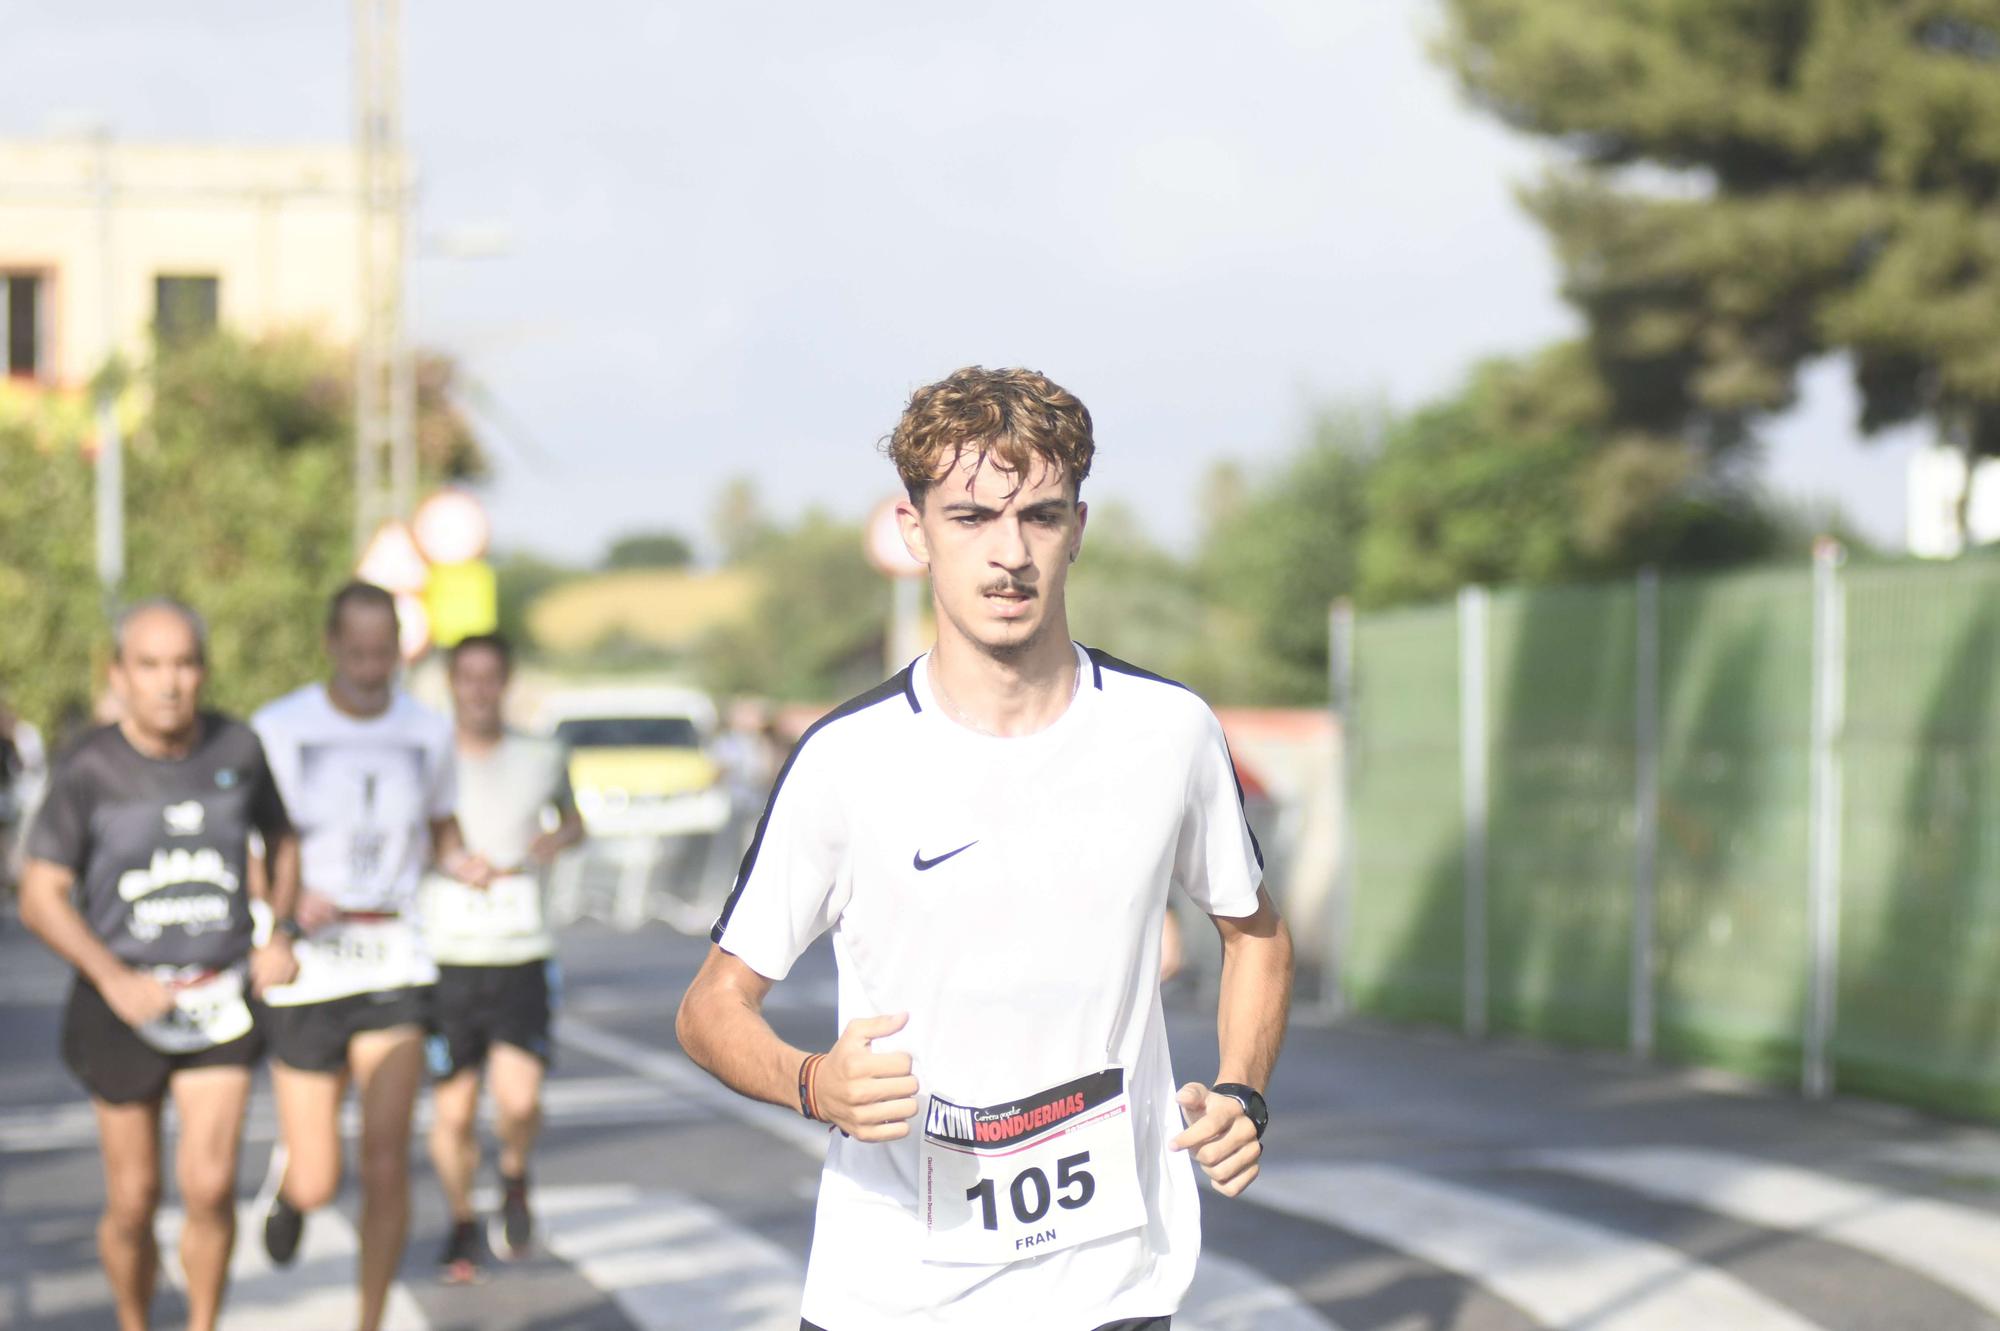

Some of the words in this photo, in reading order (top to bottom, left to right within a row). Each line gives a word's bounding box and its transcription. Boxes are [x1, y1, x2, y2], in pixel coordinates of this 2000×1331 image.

[927, 1098, 975, 1141] XXVIII
[975, 1092, 1084, 1141] NONDUERMAS
[966, 1151, 1095, 1230] 105
[1015, 1228, 1057, 1251] FRAN
